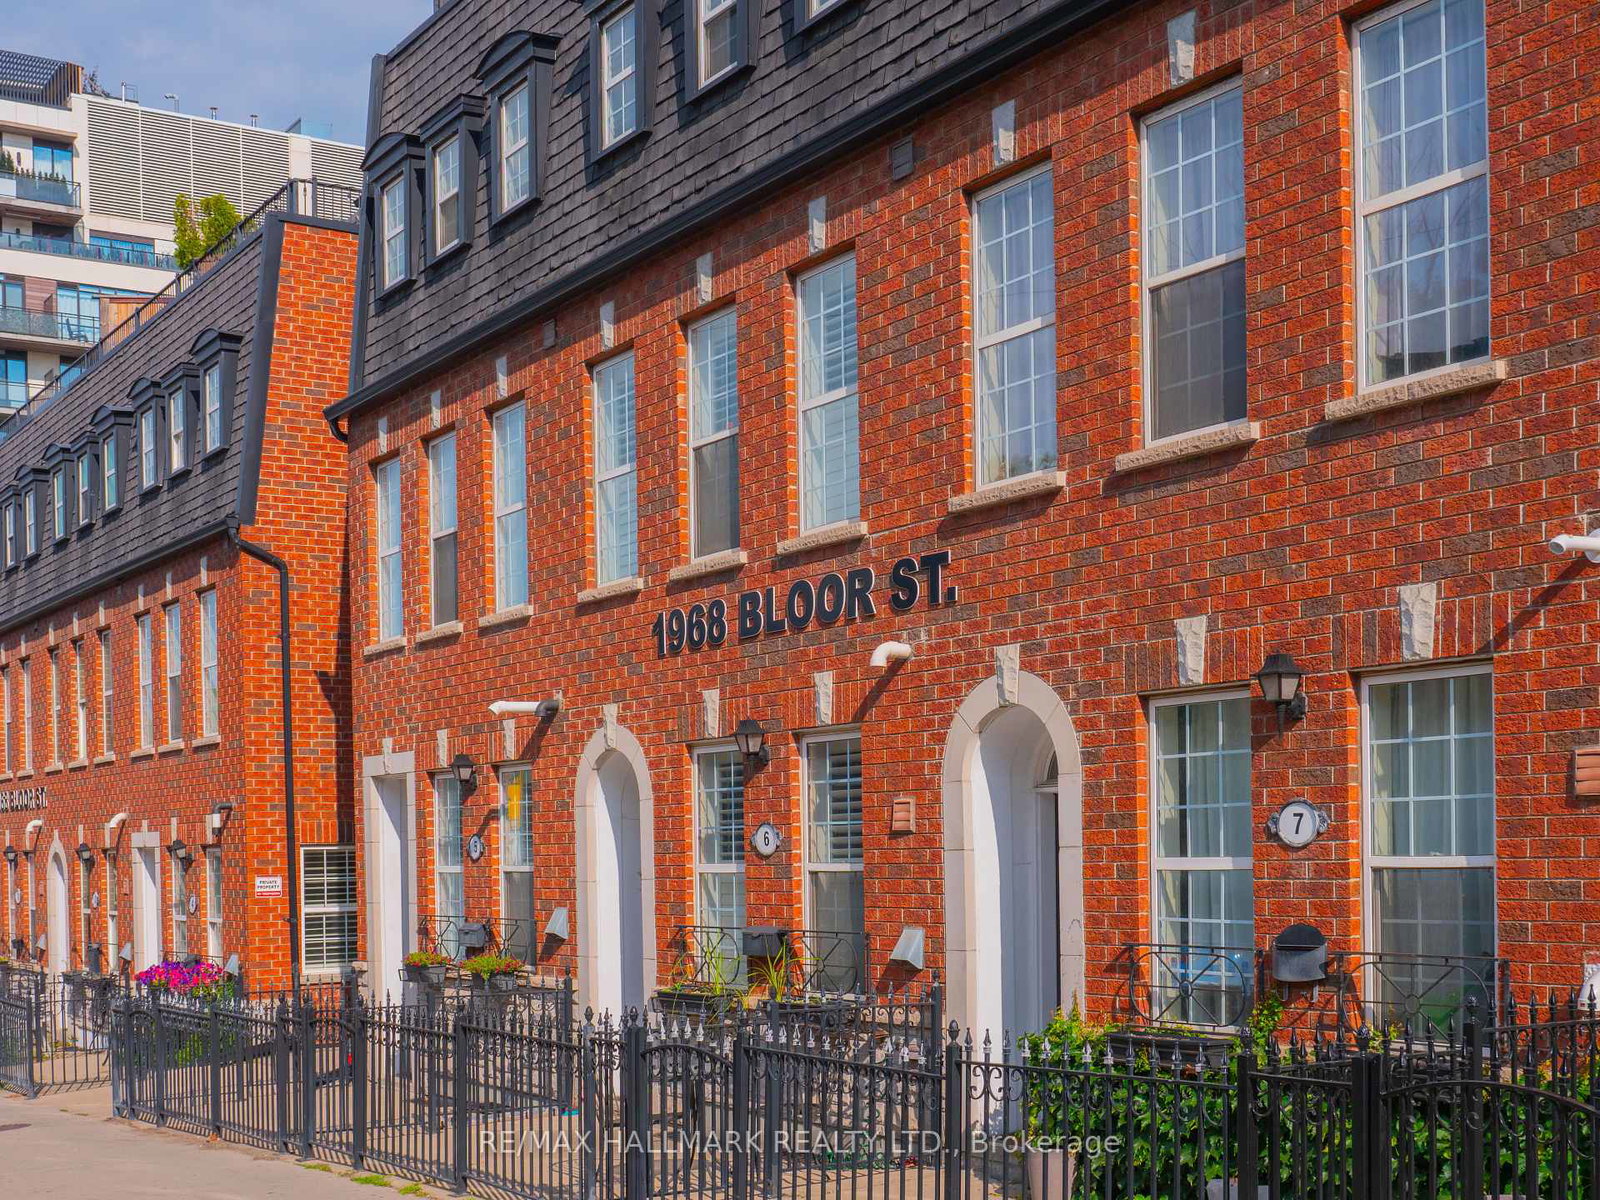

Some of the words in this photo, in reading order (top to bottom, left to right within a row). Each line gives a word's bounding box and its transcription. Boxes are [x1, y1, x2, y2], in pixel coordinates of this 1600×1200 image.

[652, 599, 728, 659] 1968
[738, 567, 878, 640] BLOOR
[889, 550, 958, 611] ST.
[1292, 812, 1305, 835] 7
[473, 840, 479, 853] 5
[763, 831, 770, 847] 6
